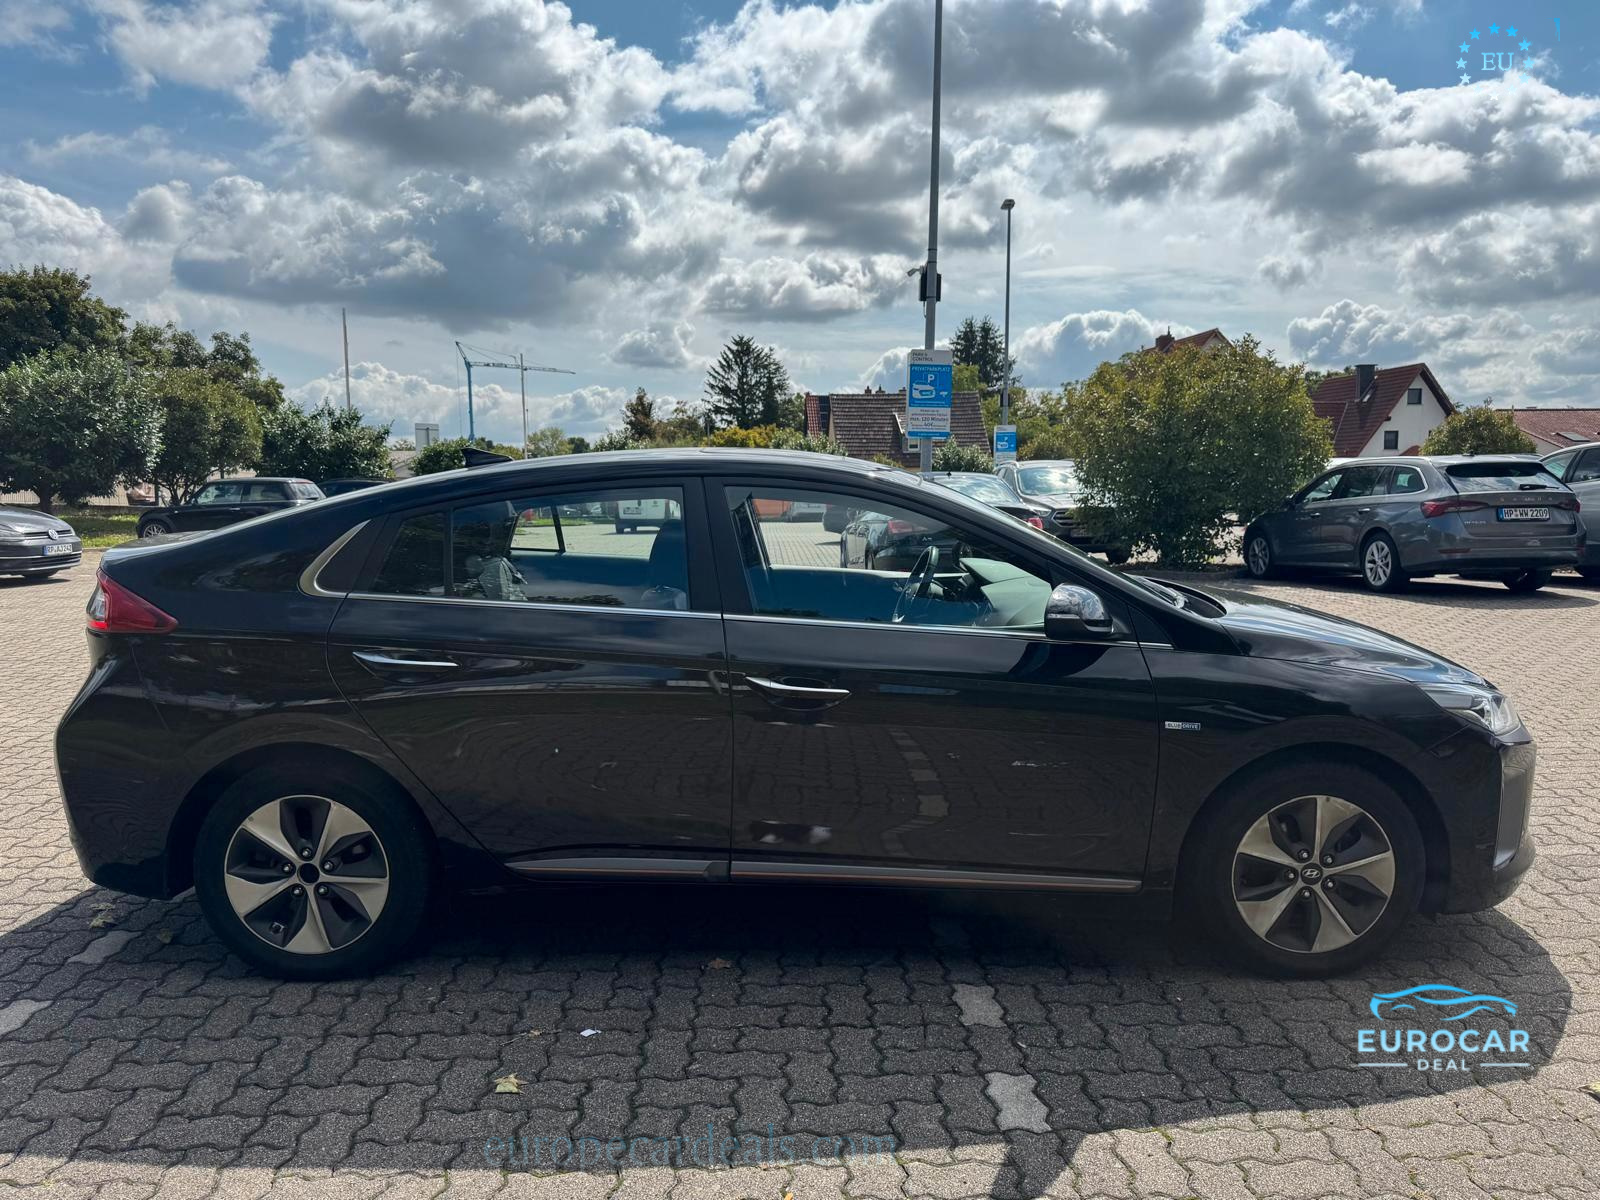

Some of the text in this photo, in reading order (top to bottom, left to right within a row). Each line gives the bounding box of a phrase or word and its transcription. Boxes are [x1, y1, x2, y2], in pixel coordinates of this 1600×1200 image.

[927, 373, 935, 384] P
[1504, 509, 1514, 518] HP
[1530, 508, 1548, 518] 2209
